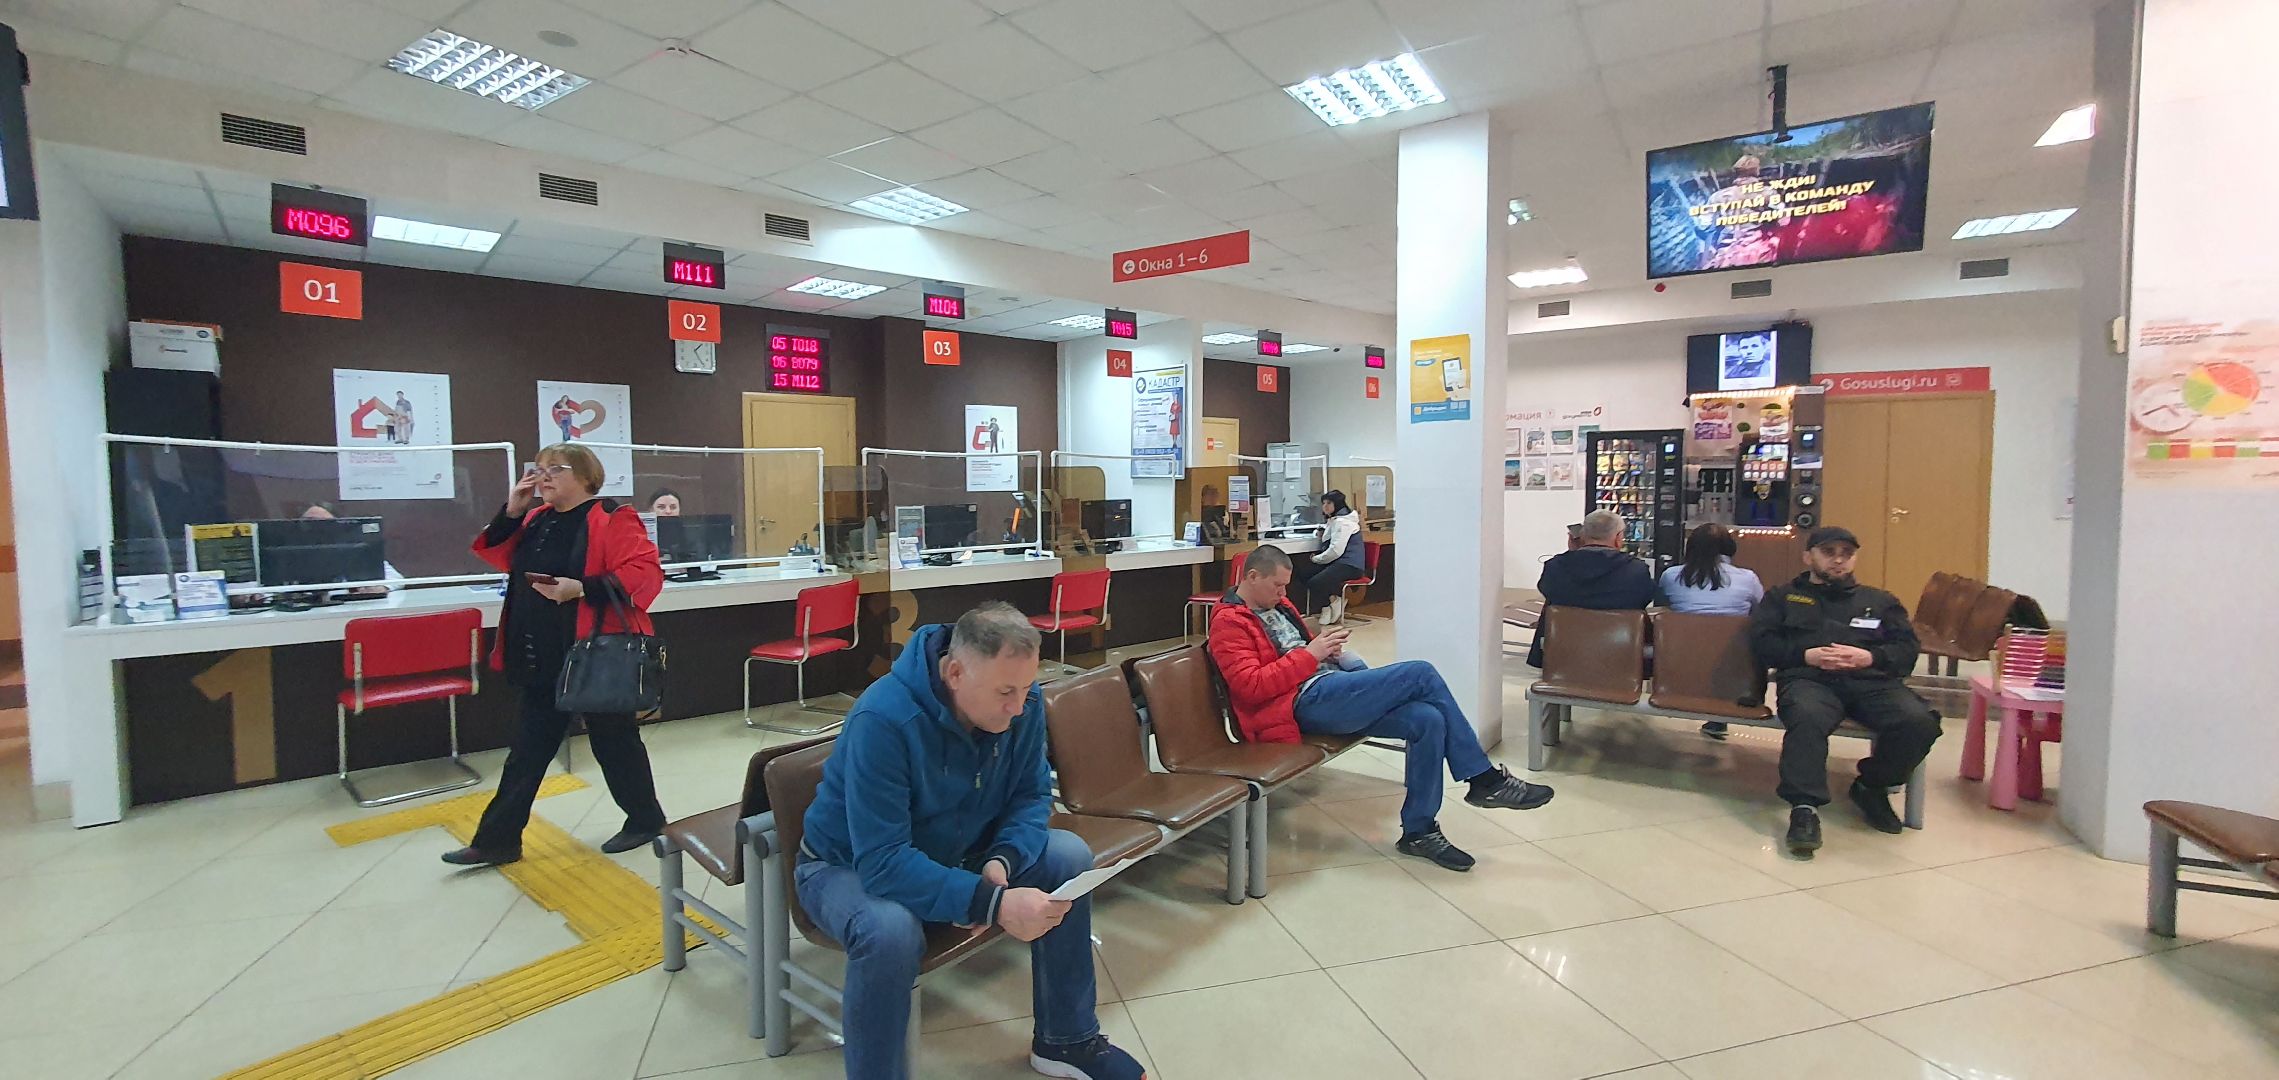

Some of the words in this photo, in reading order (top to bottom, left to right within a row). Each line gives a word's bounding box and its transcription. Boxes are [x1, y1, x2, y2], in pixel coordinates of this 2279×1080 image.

[1742, 183, 1763, 194] НЕ
[1769, 175, 1817, 190] ЖДИ!
[1689, 195, 1764, 216] ВСТУПАЙ
[1769, 194, 1780, 205] В
[1785, 181, 1877, 202] КОМАНДУ
[1716, 199, 1848, 226] ПОБЕДИТЕЛЕЙ!
[1138, 258, 1173, 273] Окна
[304, 279, 341, 304] 01
[682, 313, 707, 331] 02
[772, 336, 786, 350] 05
[933, 340, 951, 356] 03
[772, 356, 786, 368] 06
[1113, 357, 1127, 370] 04
[773, 374, 787, 386] 15
[1148, 376, 1181, 388] КАДАСТР
[1262, 373, 1273, 385] 05
[1840, 375, 1938, 391] Gosuslugi.ru
[1368, 382, 1377, 393] 06
[191, 646, 278, 785] 1
